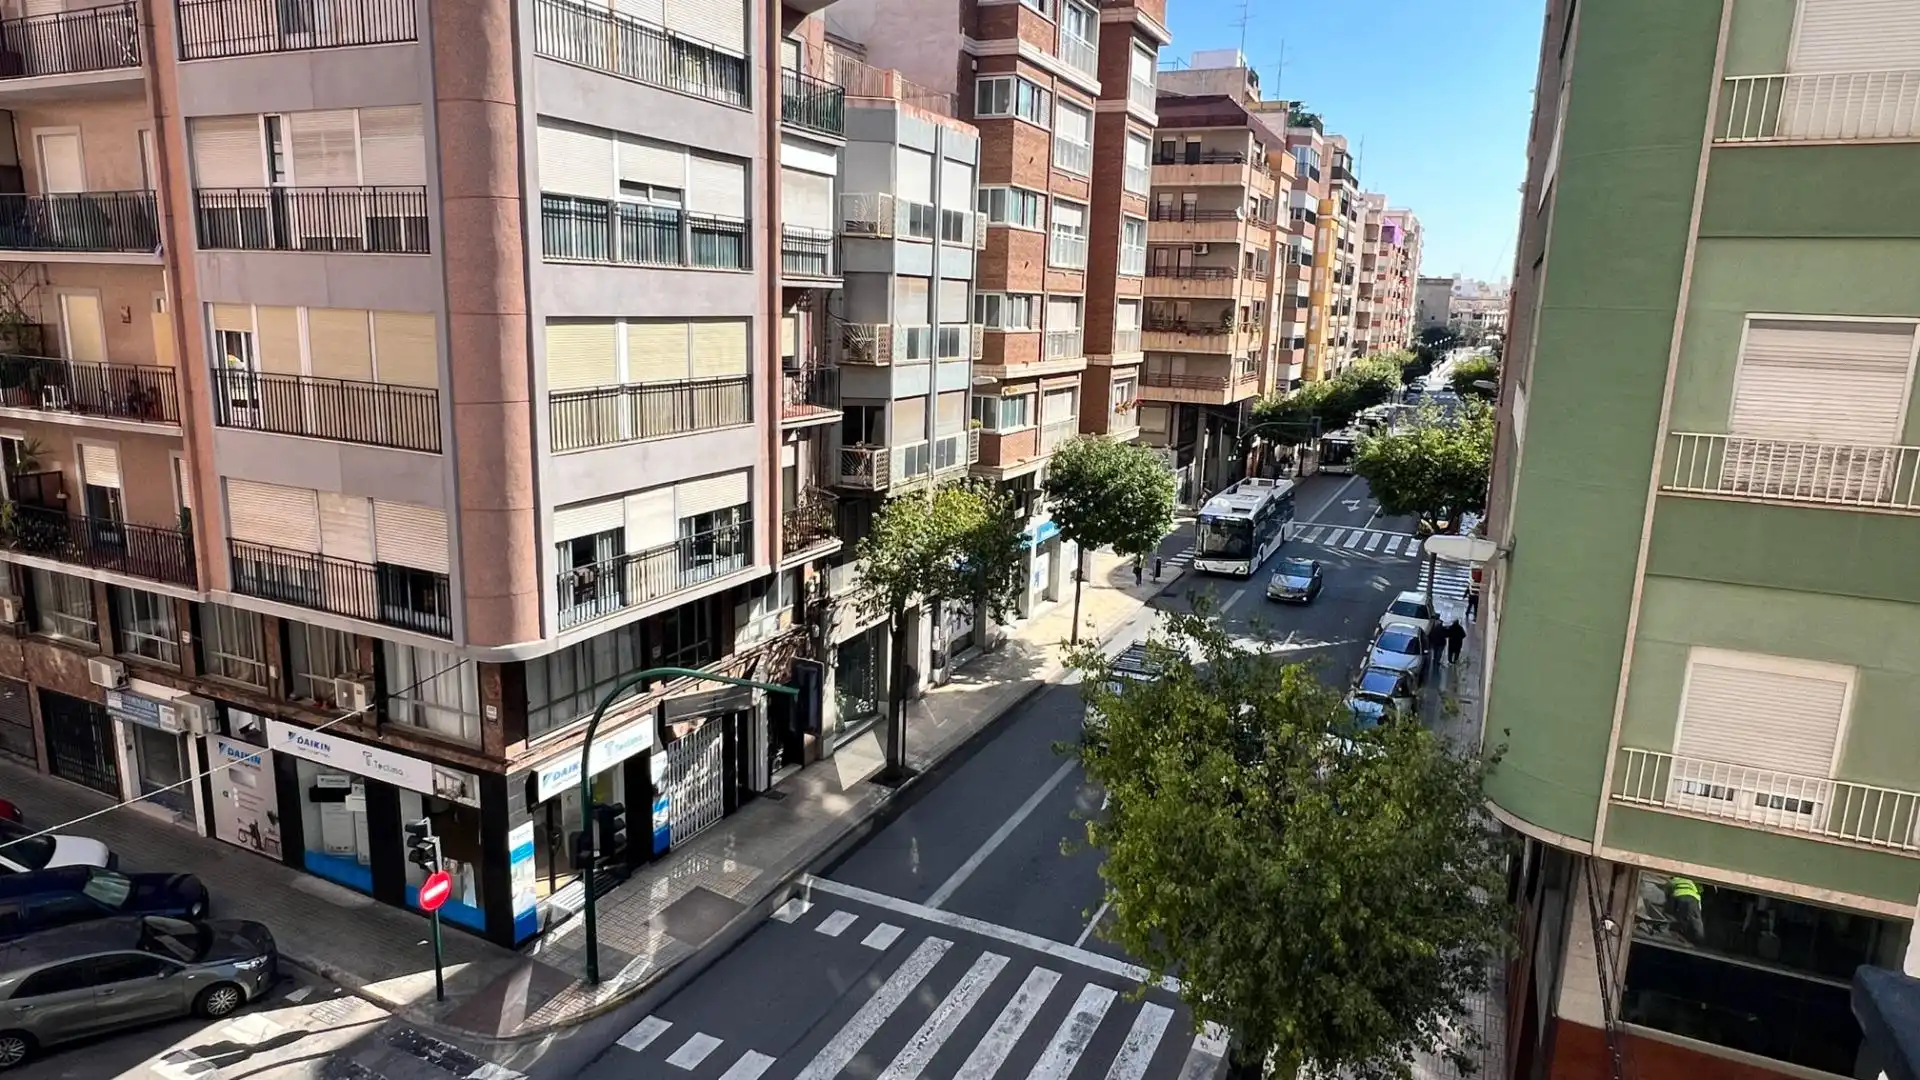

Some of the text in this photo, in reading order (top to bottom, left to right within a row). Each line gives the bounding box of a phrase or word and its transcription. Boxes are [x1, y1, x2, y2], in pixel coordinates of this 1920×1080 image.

[297, 736, 331, 752] DAIKIN
[227, 747, 261, 765] DAIKIN
[553, 761, 580, 781] DAIK
